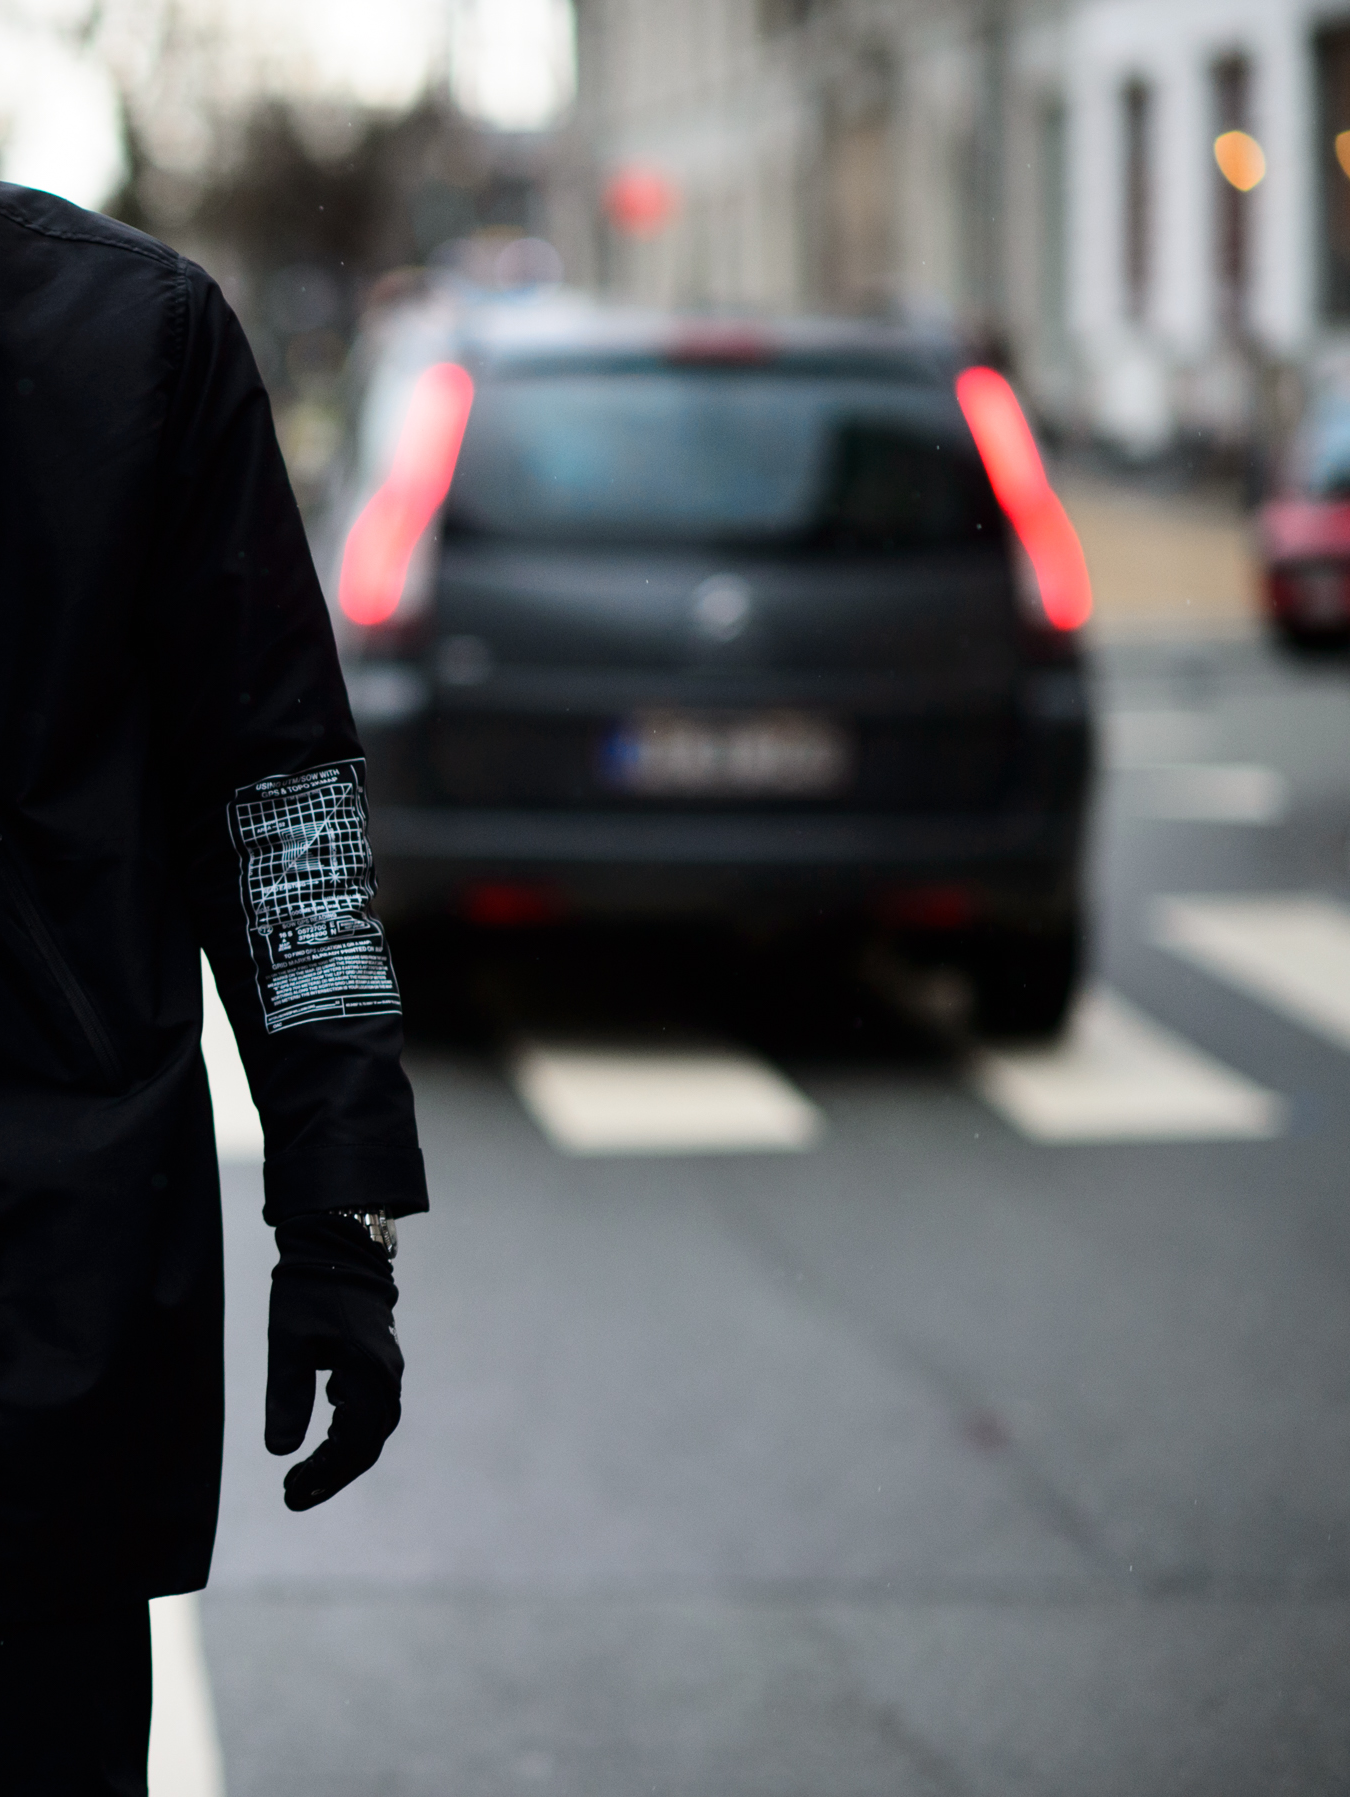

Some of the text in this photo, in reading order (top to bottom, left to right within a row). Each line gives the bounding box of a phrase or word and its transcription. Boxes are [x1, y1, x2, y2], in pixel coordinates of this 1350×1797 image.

[255, 782, 282, 790] USING
[319, 769, 340, 778] WITH
[261, 789, 280, 798] GPS
[287, 783, 310, 793] TOPO
